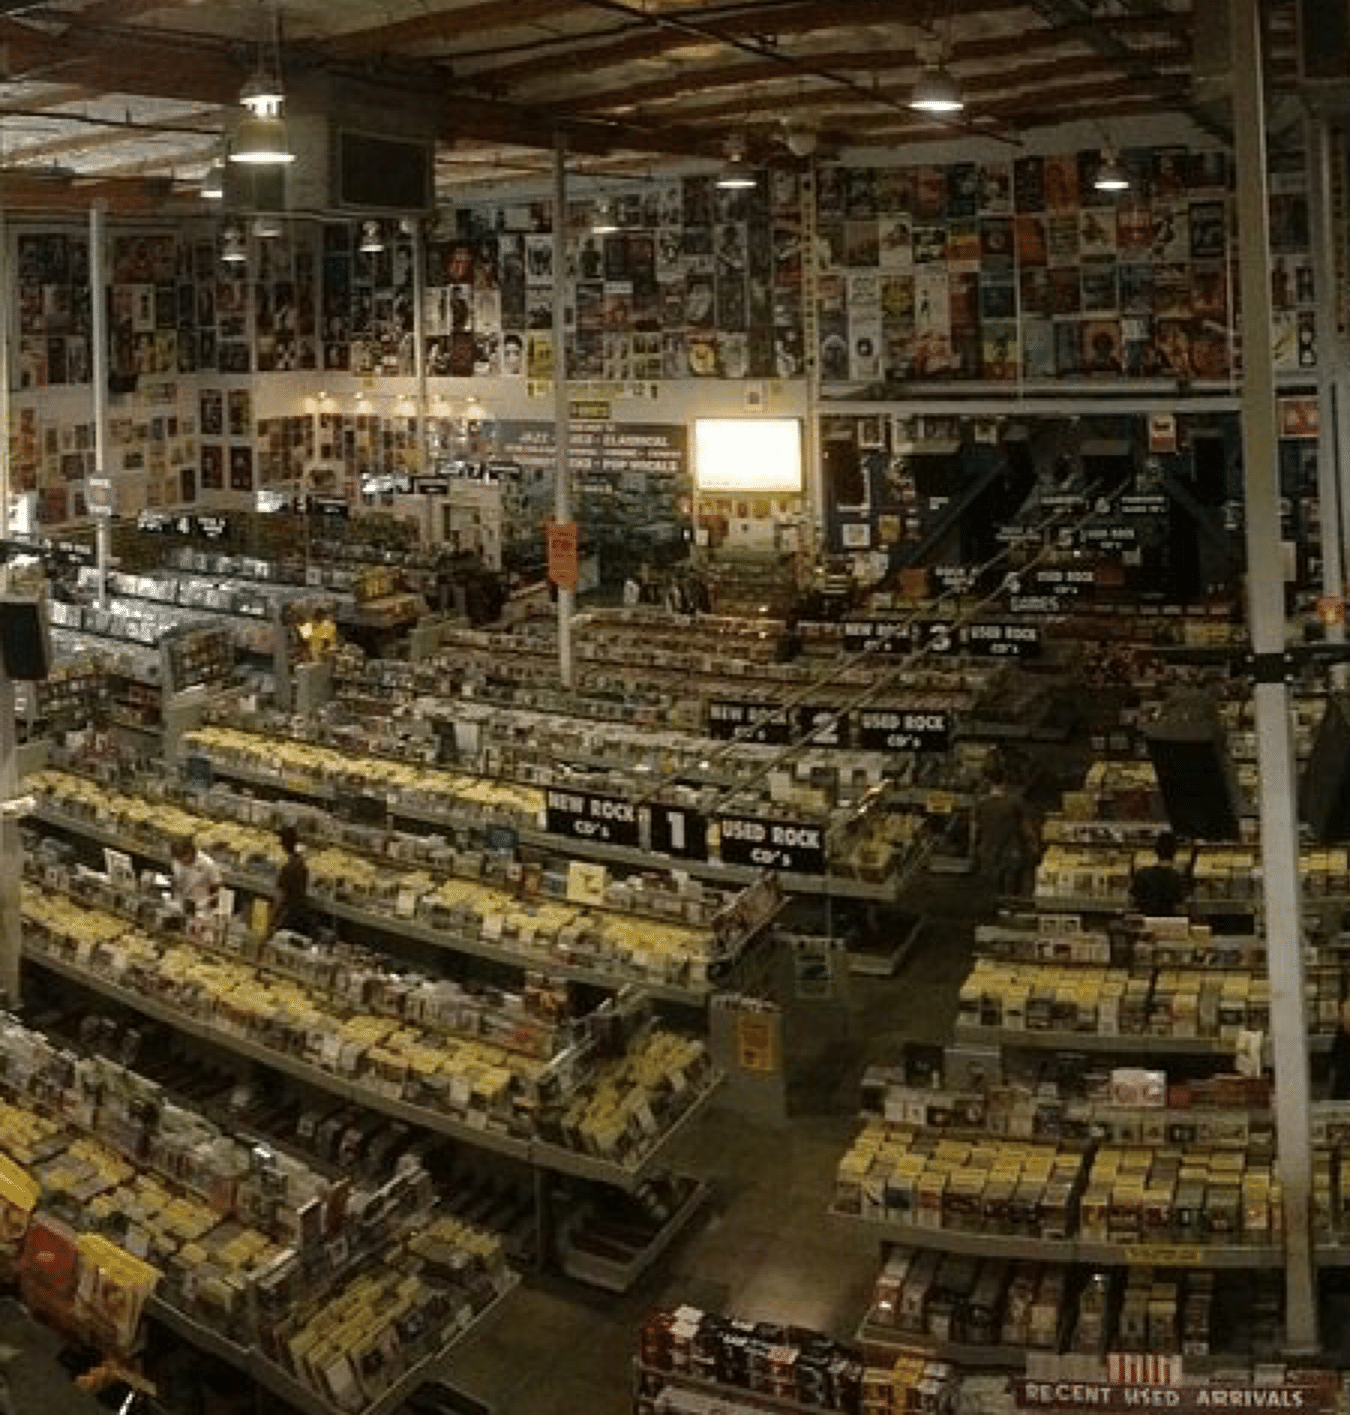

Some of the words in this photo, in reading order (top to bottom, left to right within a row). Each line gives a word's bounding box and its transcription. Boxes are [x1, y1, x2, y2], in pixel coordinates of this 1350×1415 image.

[929, 624, 952, 651] 3
[970, 625, 1003, 639] USED
[1004, 627, 1037, 642] ROCK
[710, 705, 743, 722] NEW
[747, 707, 788, 724] ROCK
[811, 711, 840, 745] 2
[862, 713, 901, 731] USED
[903, 714, 946, 732] ROCK
[548, 791, 584, 814] NEW
[590, 798, 634, 823] ROCK
[665, 811, 686, 849] 1
[722, 819, 766, 843] USED
[769, 825, 821, 850] ROCK
[1025, 1381, 1112, 1403] RECENT
[1124, 1386, 1181, 1408] USED
[1196, 1388, 1304, 1408] ARRIVALS
